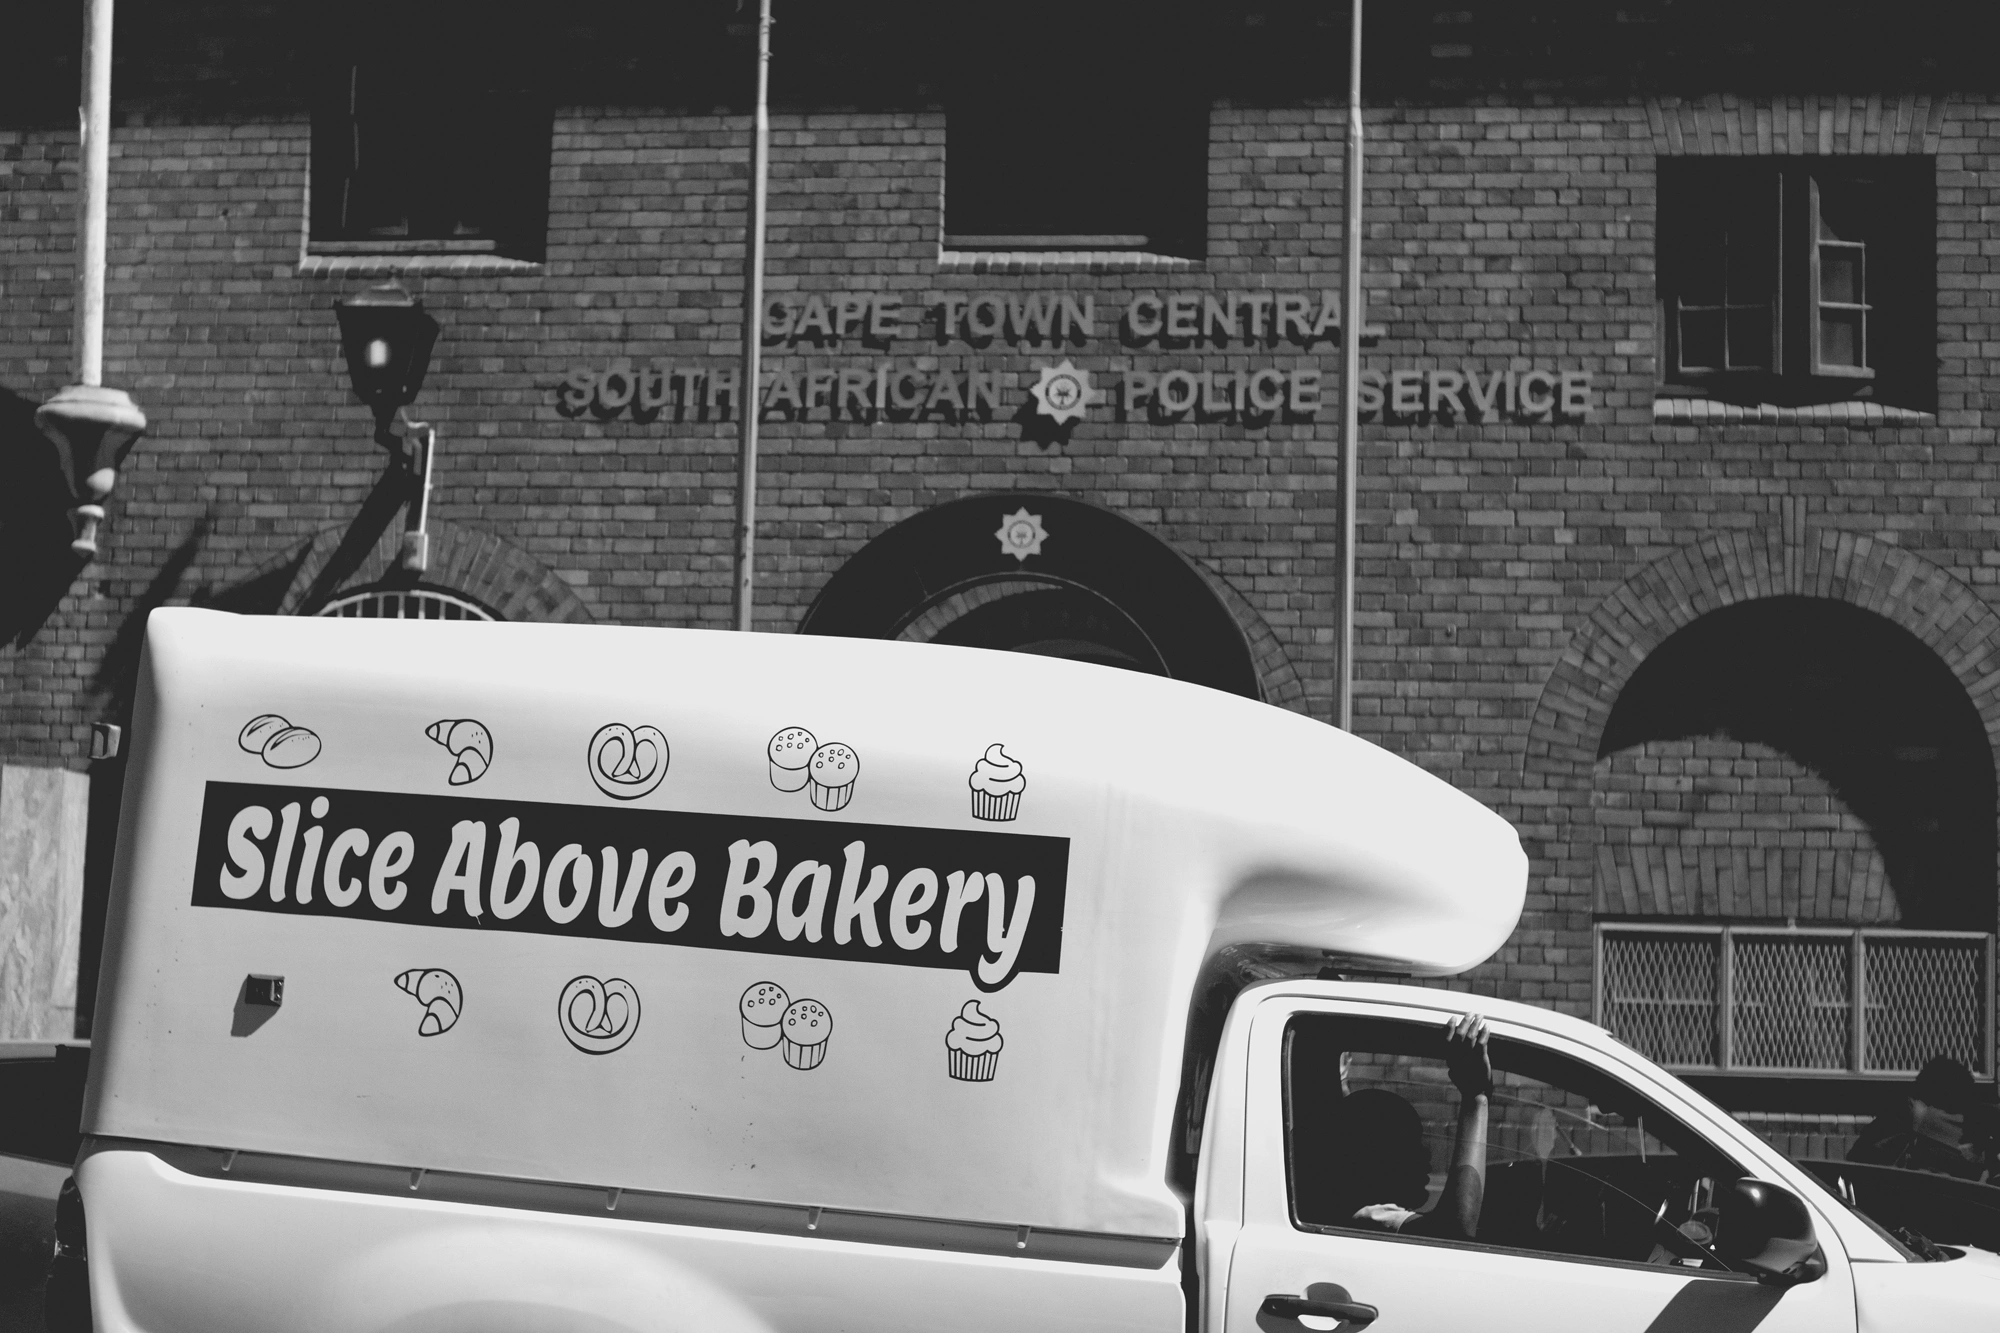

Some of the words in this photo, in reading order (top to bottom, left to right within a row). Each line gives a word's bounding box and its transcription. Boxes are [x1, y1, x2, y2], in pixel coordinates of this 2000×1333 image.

[761, 294, 899, 335] CAPE
[936, 294, 1094, 335] TOWN
[1127, 294, 1386, 336] CENTRAL
[564, 366, 740, 408] SOUTH
[765, 366, 1002, 409] AFRICAN
[1124, 369, 1322, 411] POLICE
[1357, 369, 1594, 412] SERVICE
[219, 796, 415, 912] Slice
[430, 817, 697, 933] Above
[718, 839, 1036, 984] Bakery
